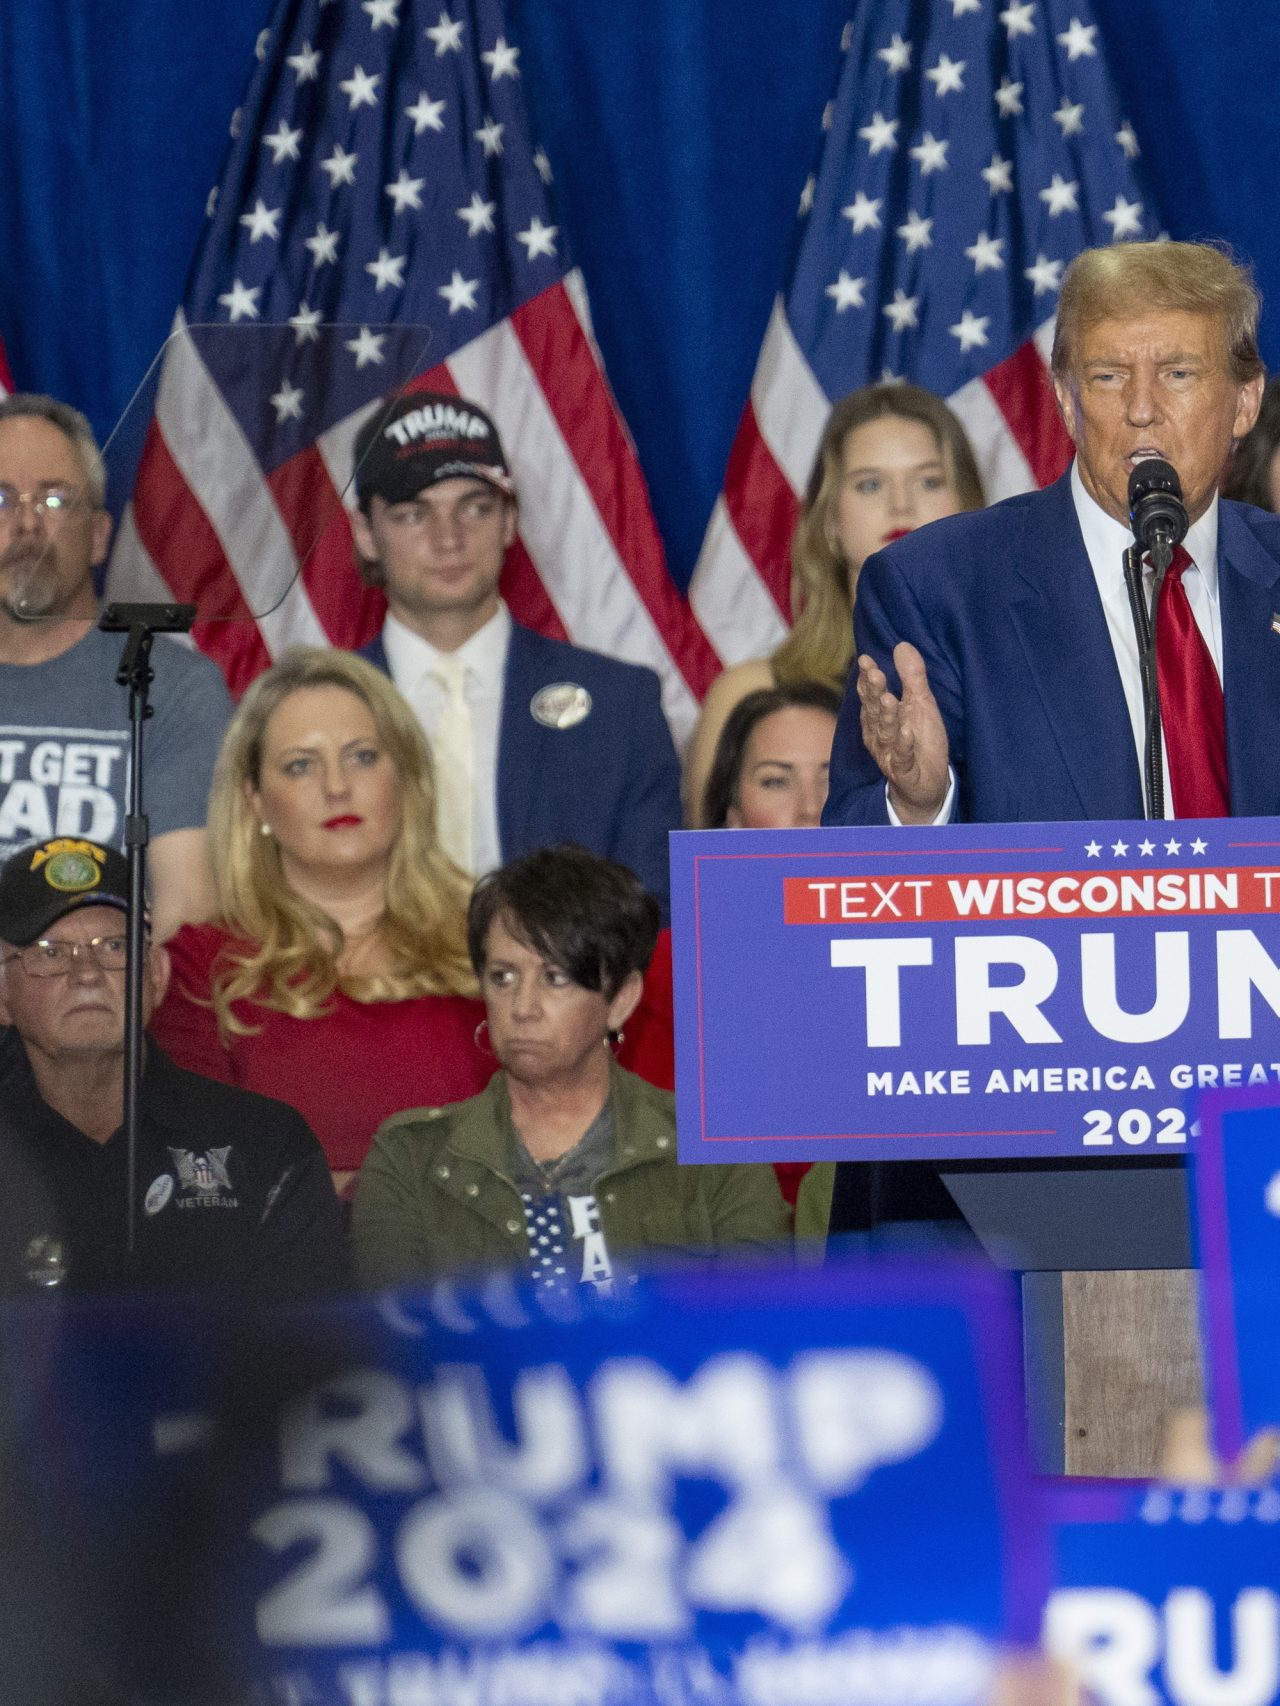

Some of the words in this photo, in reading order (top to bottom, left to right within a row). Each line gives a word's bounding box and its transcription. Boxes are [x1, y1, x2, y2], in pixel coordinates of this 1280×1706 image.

[384, 403, 489, 446] TRUMP
[29, 741, 122, 787] GET
[807, 880, 933, 919] TEXT
[947, 872, 1238, 915] WISCONSIN
[866, 1070, 971, 1097] MAKE
[984, 1065, 1156, 1095] AMERICA
[175, 1196, 239, 1209] VETERAN
[280, 1346, 943, 1492] RUMP
